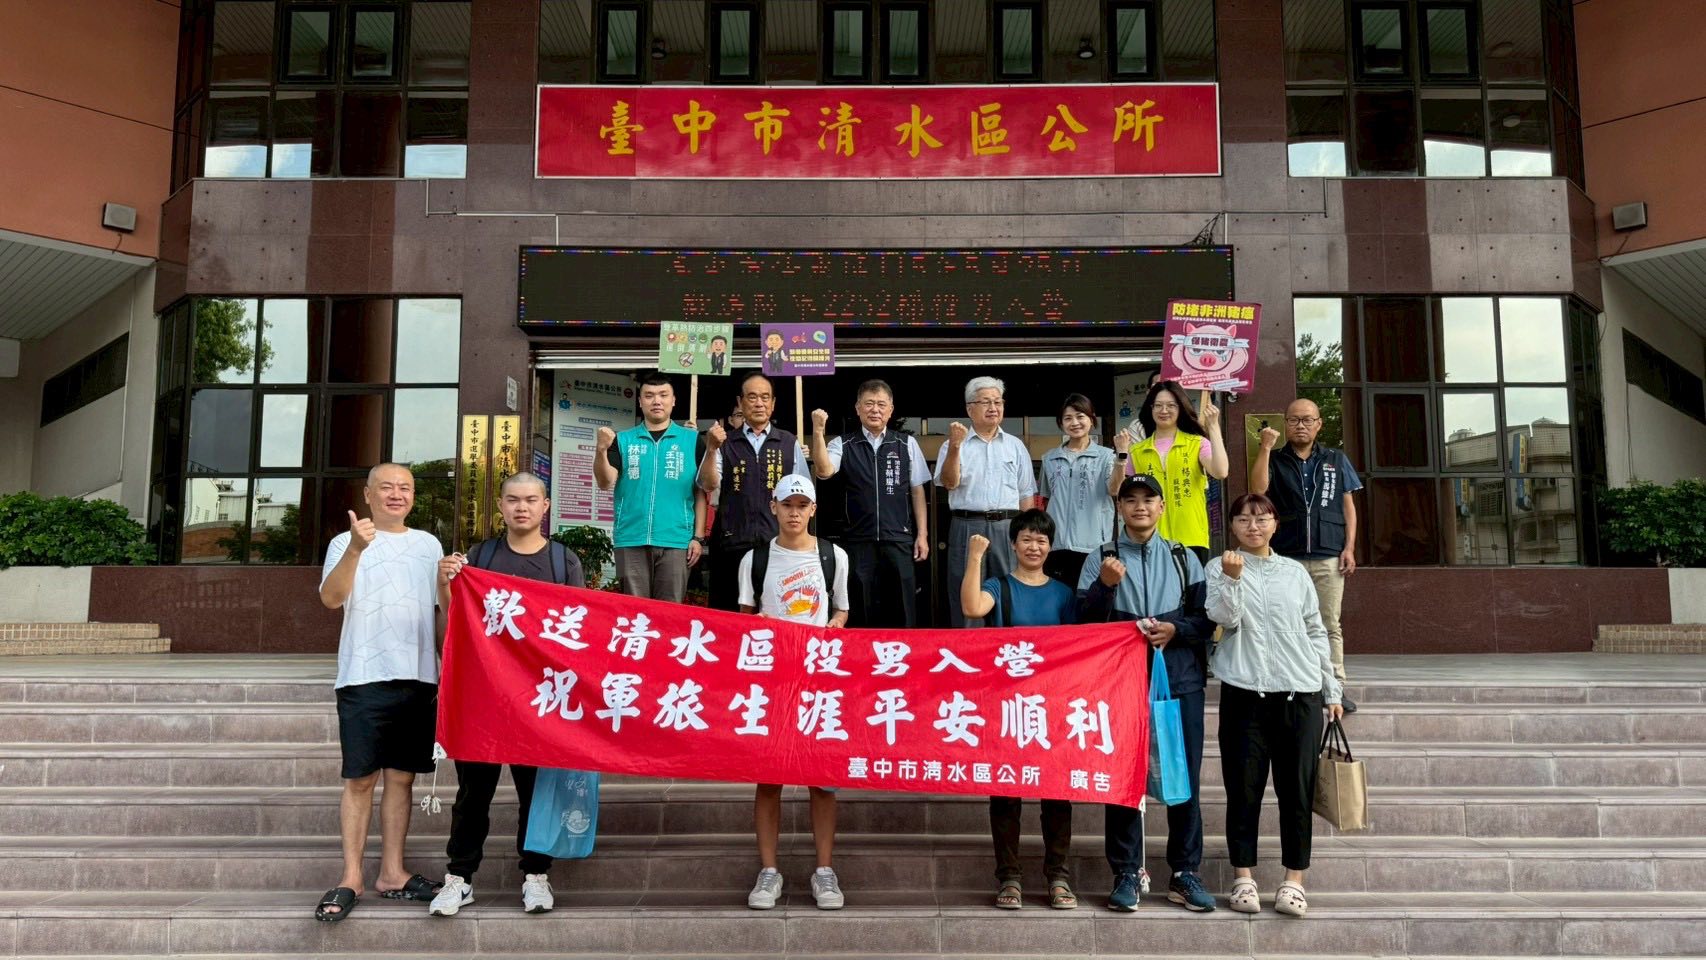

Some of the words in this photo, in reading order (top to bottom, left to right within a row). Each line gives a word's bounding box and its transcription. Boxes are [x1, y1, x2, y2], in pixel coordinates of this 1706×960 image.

[599, 99, 1163, 157] 臺中市清水區公所
[1172, 303, 1254, 320] 防堵非洲豬瘟
[500, 420, 512, 480] 臺中市清水
[483, 588, 1044, 677] 歡送清水區役男入營
[530, 667, 1114, 755] 祝軍旅生涯平安順利
[847, 757, 1041, 787] 臺中市清水區公所
[1070, 769, 1112, 792] 廣告
